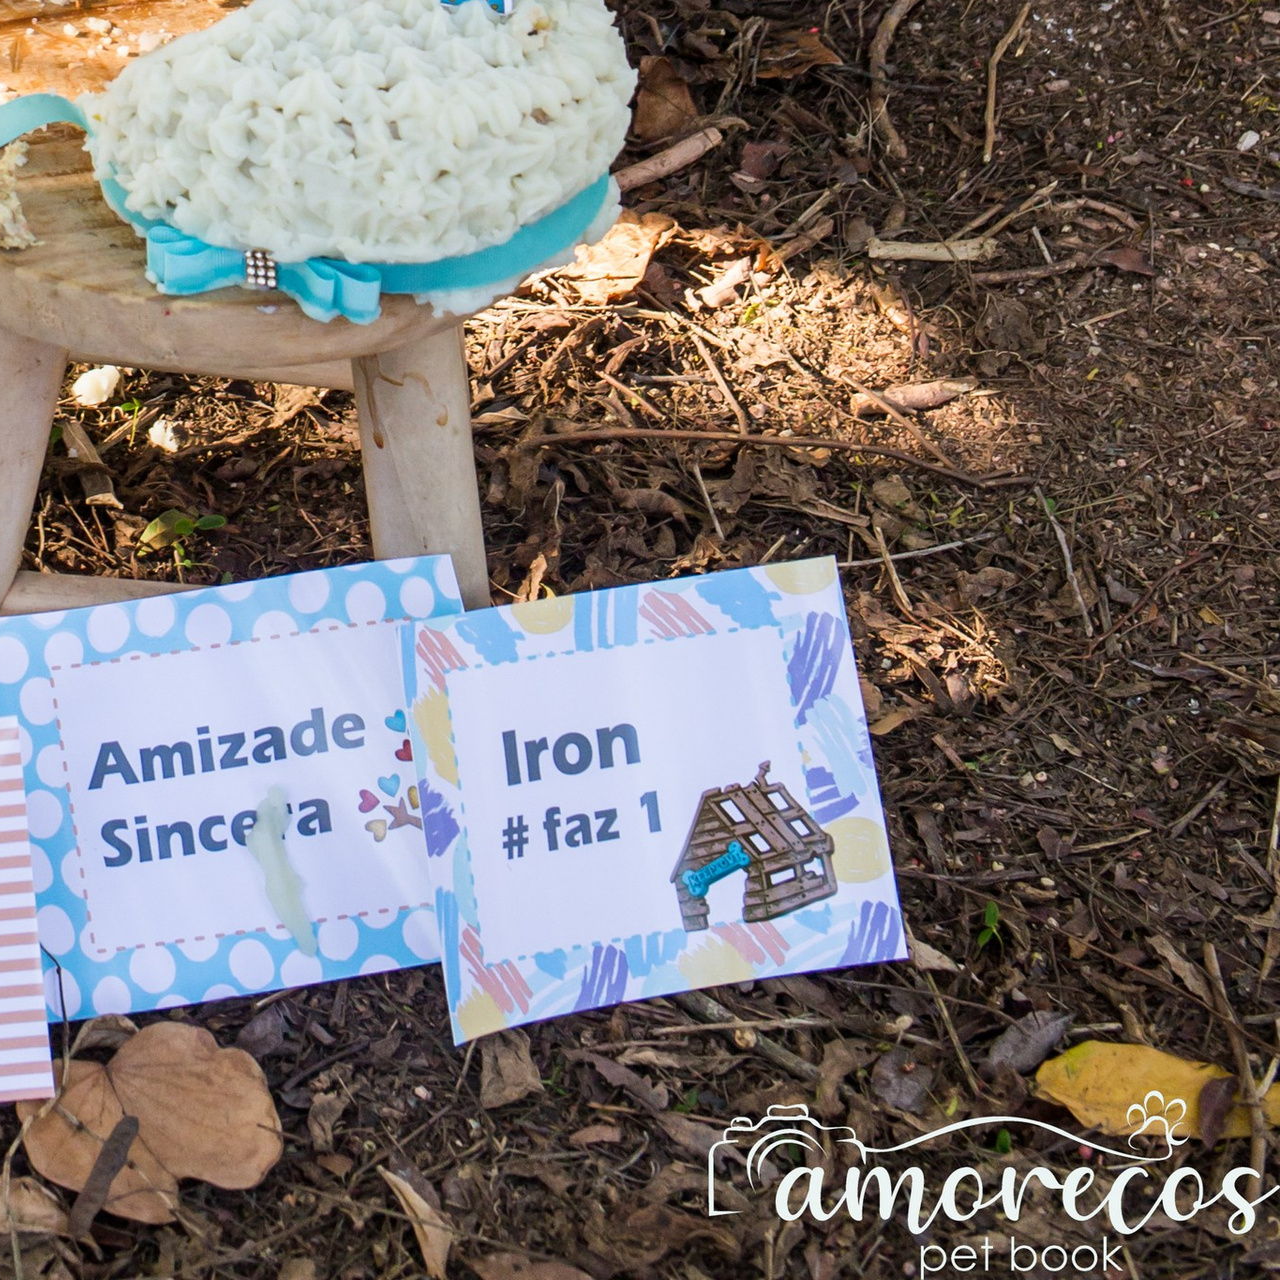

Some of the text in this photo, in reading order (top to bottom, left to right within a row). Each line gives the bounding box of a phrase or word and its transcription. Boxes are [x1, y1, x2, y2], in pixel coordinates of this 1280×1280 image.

[88, 707, 366, 790] Amizade
[501, 723, 641, 786] Iron
[100, 798, 332, 868] Sincea
[542, 806, 620, 852] faz
[639, 790, 662, 833] 1
